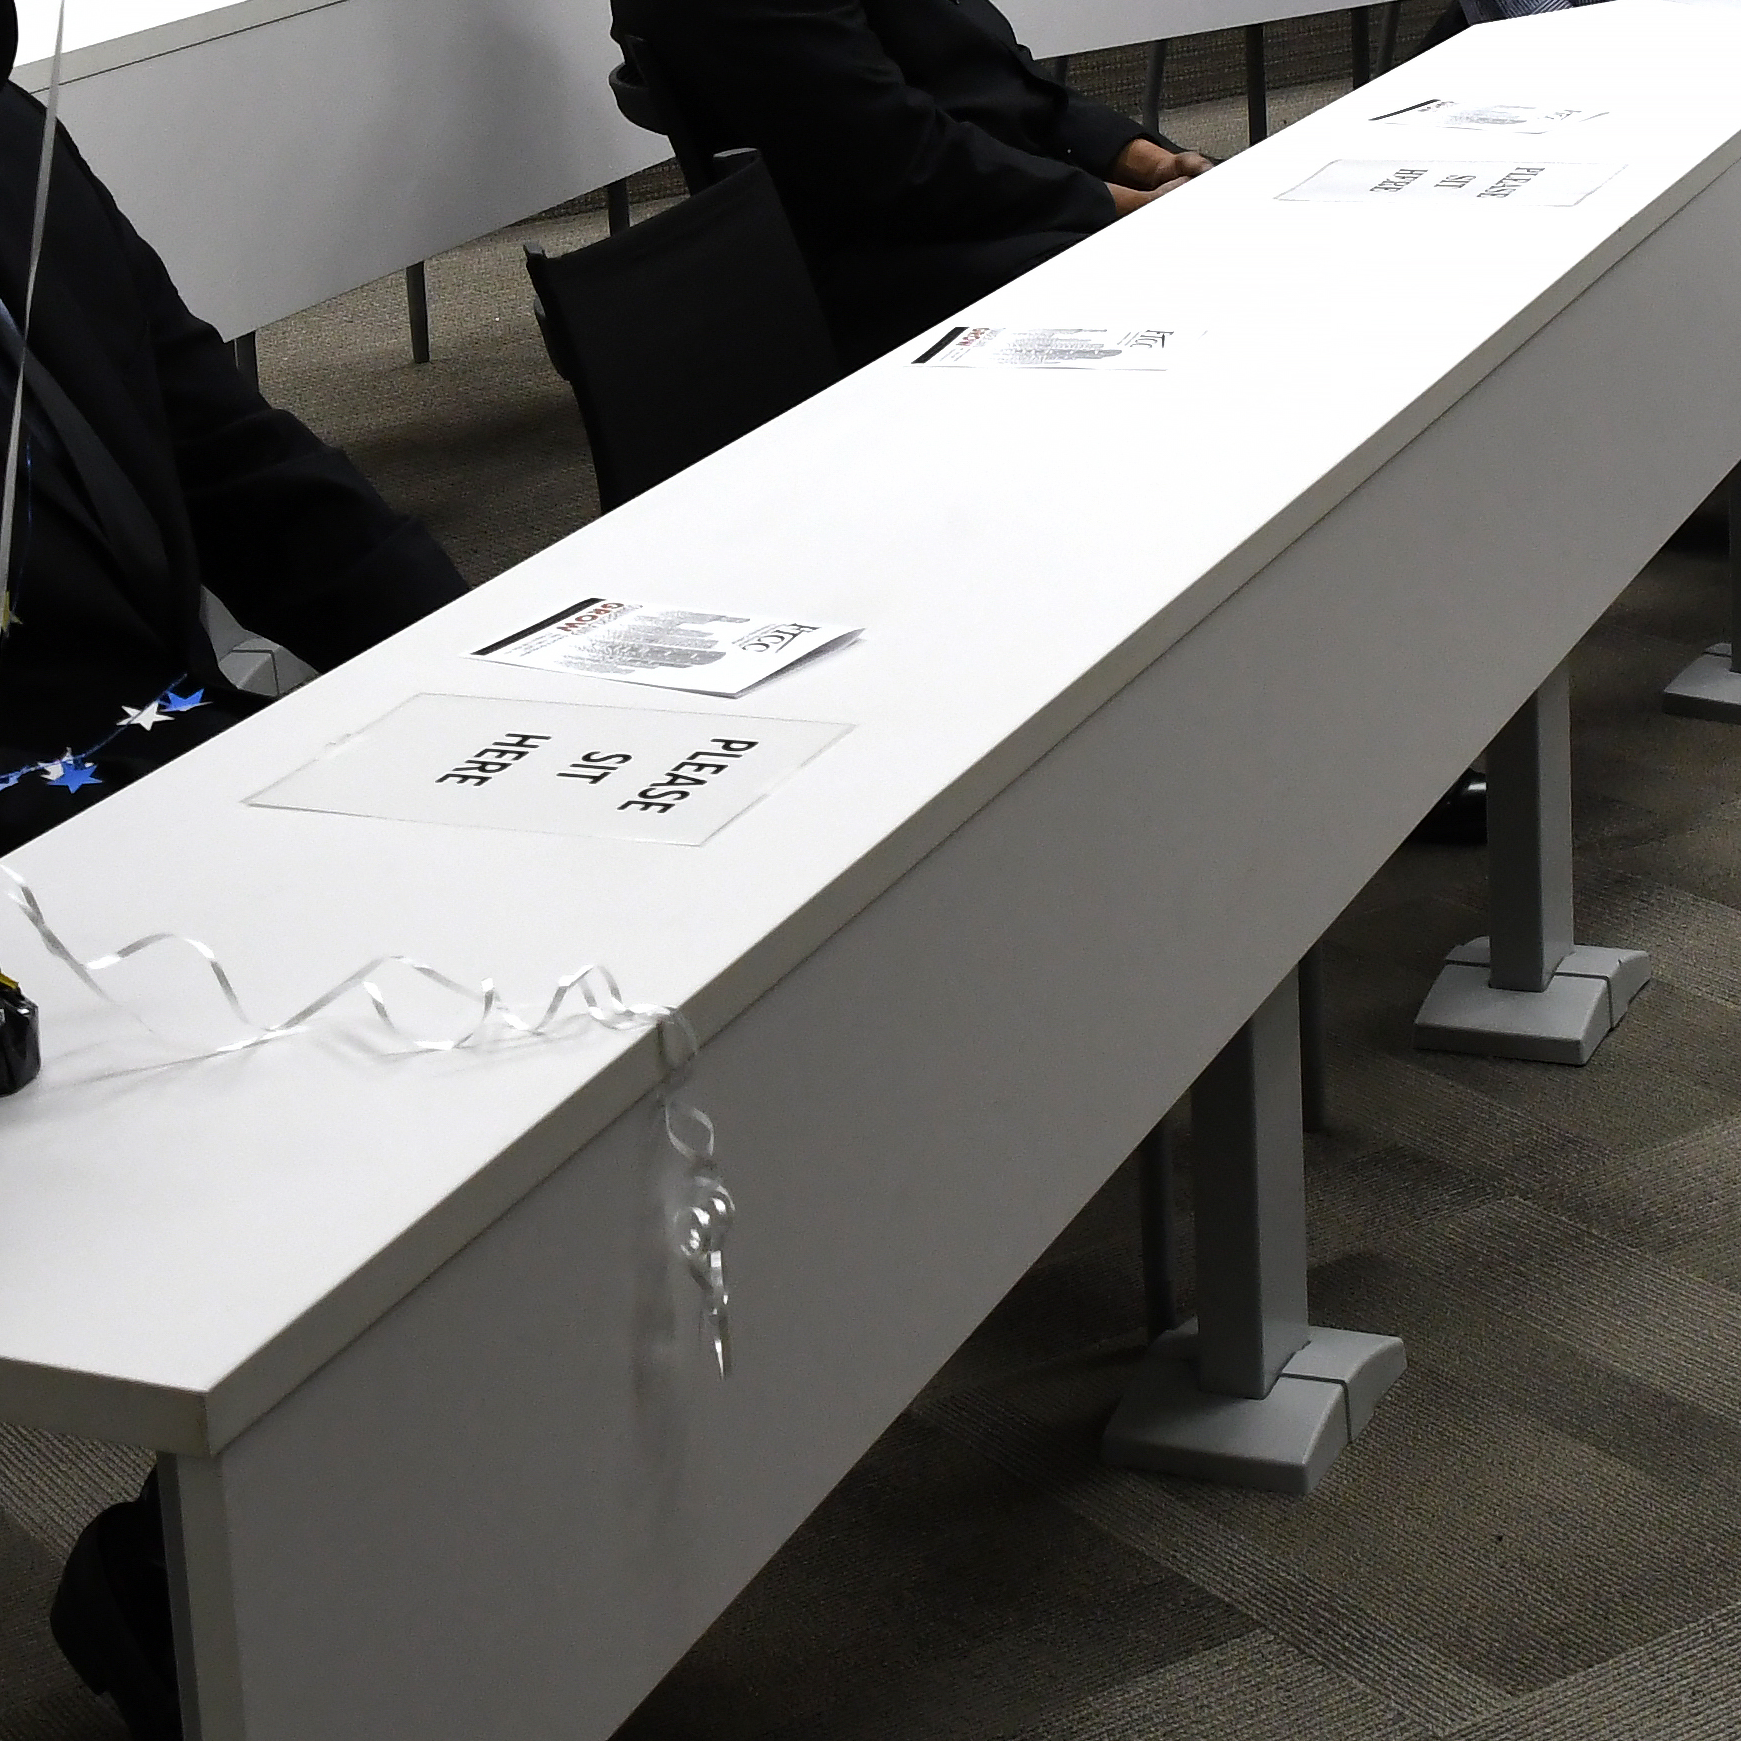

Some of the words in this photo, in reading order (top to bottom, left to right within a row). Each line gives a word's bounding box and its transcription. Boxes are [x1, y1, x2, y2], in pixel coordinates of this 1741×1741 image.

[557, 602, 625, 634] GROW
[434, 732, 552, 787] HERE
[555, 751, 633, 785] SIT
[616, 738, 759, 814] PLEASE
